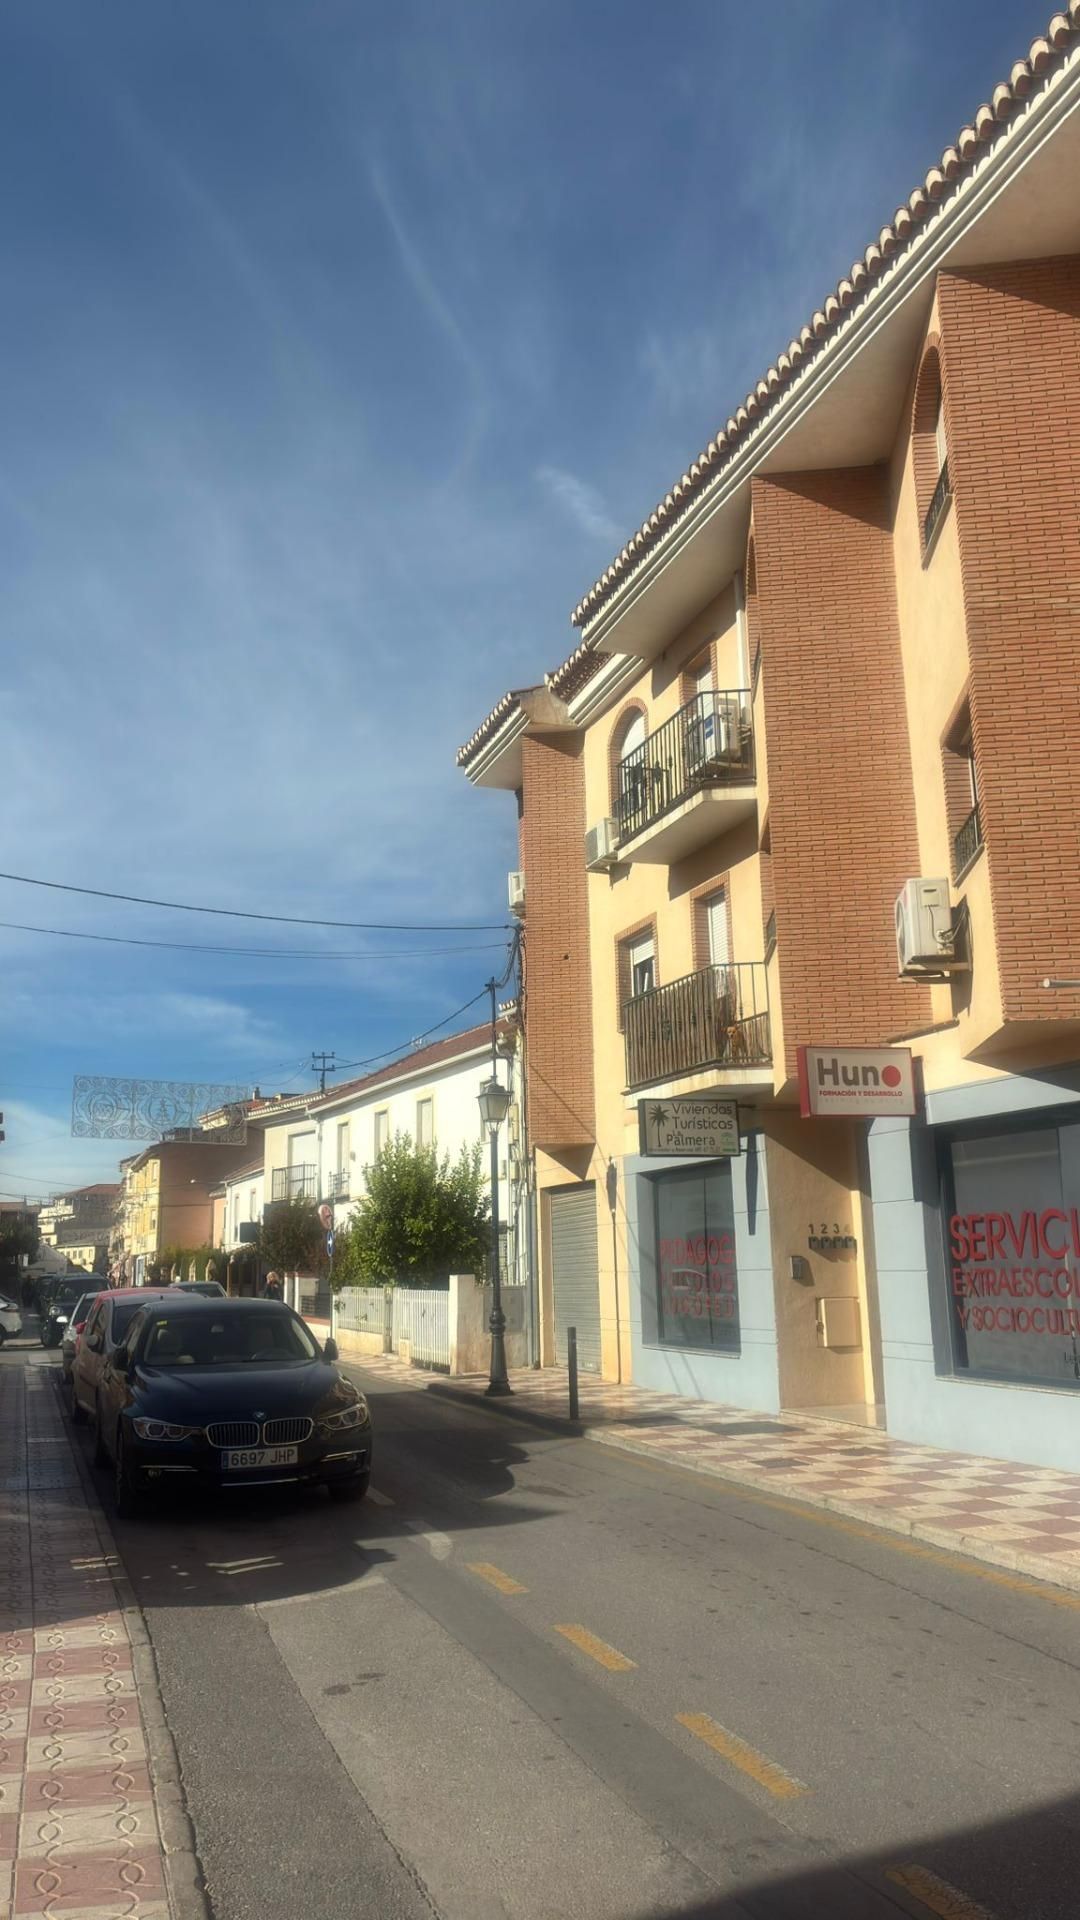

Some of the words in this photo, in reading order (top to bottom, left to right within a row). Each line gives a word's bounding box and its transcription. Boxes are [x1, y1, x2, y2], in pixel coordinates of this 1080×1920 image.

[671, 1103, 732, 1114] Viviendas
[672, 1116, 733, 1129] Turísticas
[666, 1134, 715, 1146] Palmera
[820, 1223, 828, 1234] 2
[833, 1223, 840, 1234] 3
[956, 1304, 971, 1331] Y
[232, 1452, 265, 1466] 6697
[271, 1449, 294, 1464] JHP
